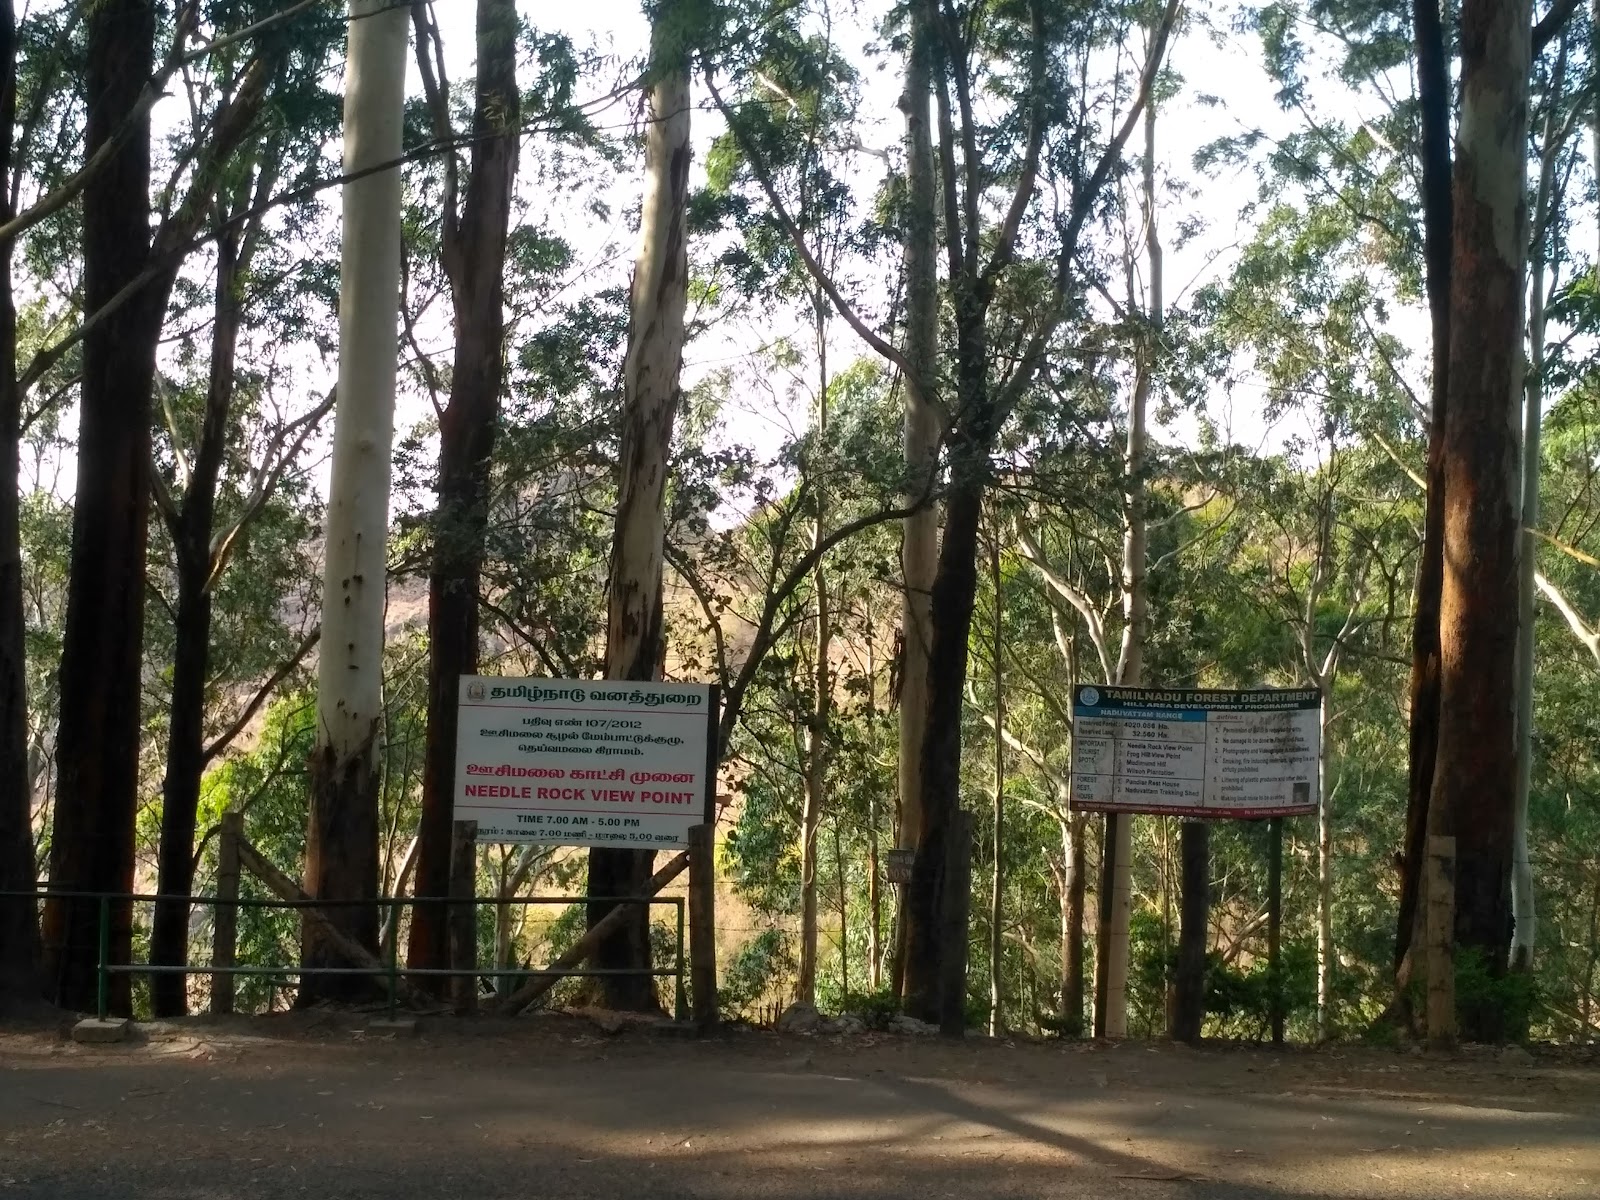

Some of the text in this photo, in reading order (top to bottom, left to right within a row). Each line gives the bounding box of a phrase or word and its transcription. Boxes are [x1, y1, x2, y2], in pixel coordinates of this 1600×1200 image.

[490, 685, 702, 706] தமிழ்நாடு வனத்துறை
[1105, 690, 1317, 702] TAMILNADU FOREST DEPARTMENT
[1101, 709, 1153, 718] NADUVATTAM
[522, 717, 642, 730] பதிவு எண் 107/2012
[480, 729, 543, 738] ஊசிமலை
[546, 731, 579, 741] சூழல்
[518, 744, 592, 754] தெய்வமலை
[1127, 751, 1140, 759] Frog
[466, 764, 695, 785] ஊசிமலை காட்சி முனை
[465, 784, 695, 805] NEEDLE ROCK VIEW POINT
[516, 814, 543, 824] TIME
[547, 816, 569, 825] 7.00
[572, 817, 588, 825] AM
[598, 818, 620, 827] 5.00
[623, 819, 640, 827] PM
[540, 829, 562, 837] 7.00
[564, 830, 587, 838] மணி
